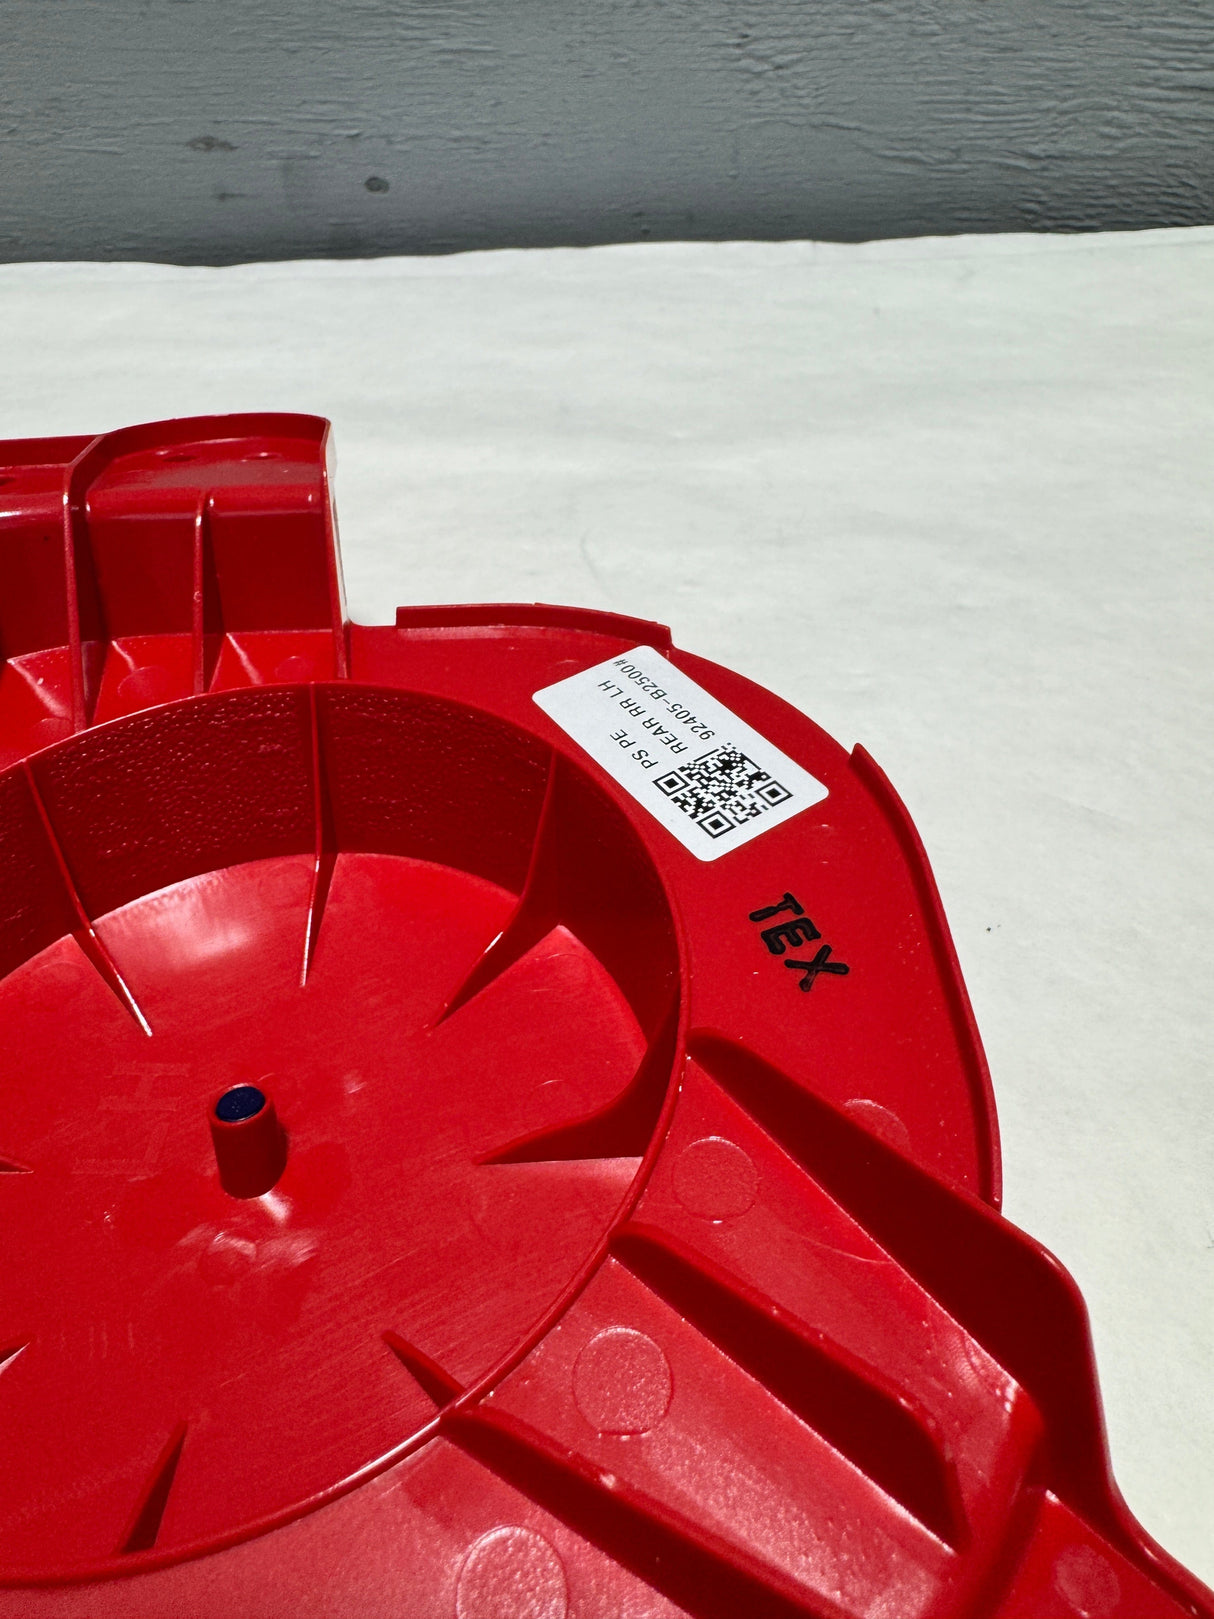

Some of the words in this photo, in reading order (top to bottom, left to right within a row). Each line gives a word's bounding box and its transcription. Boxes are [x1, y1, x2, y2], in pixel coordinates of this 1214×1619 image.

[598, 680, 624, 698] LH
[613, 659, 716, 740] 92405-B2500#
[619, 697, 646, 717] RR
[609, 729, 636, 749] PE
[642, 717, 688, 754] REAR
[632, 750, 659, 769] PS
[749, 892, 850, 992] TEX
